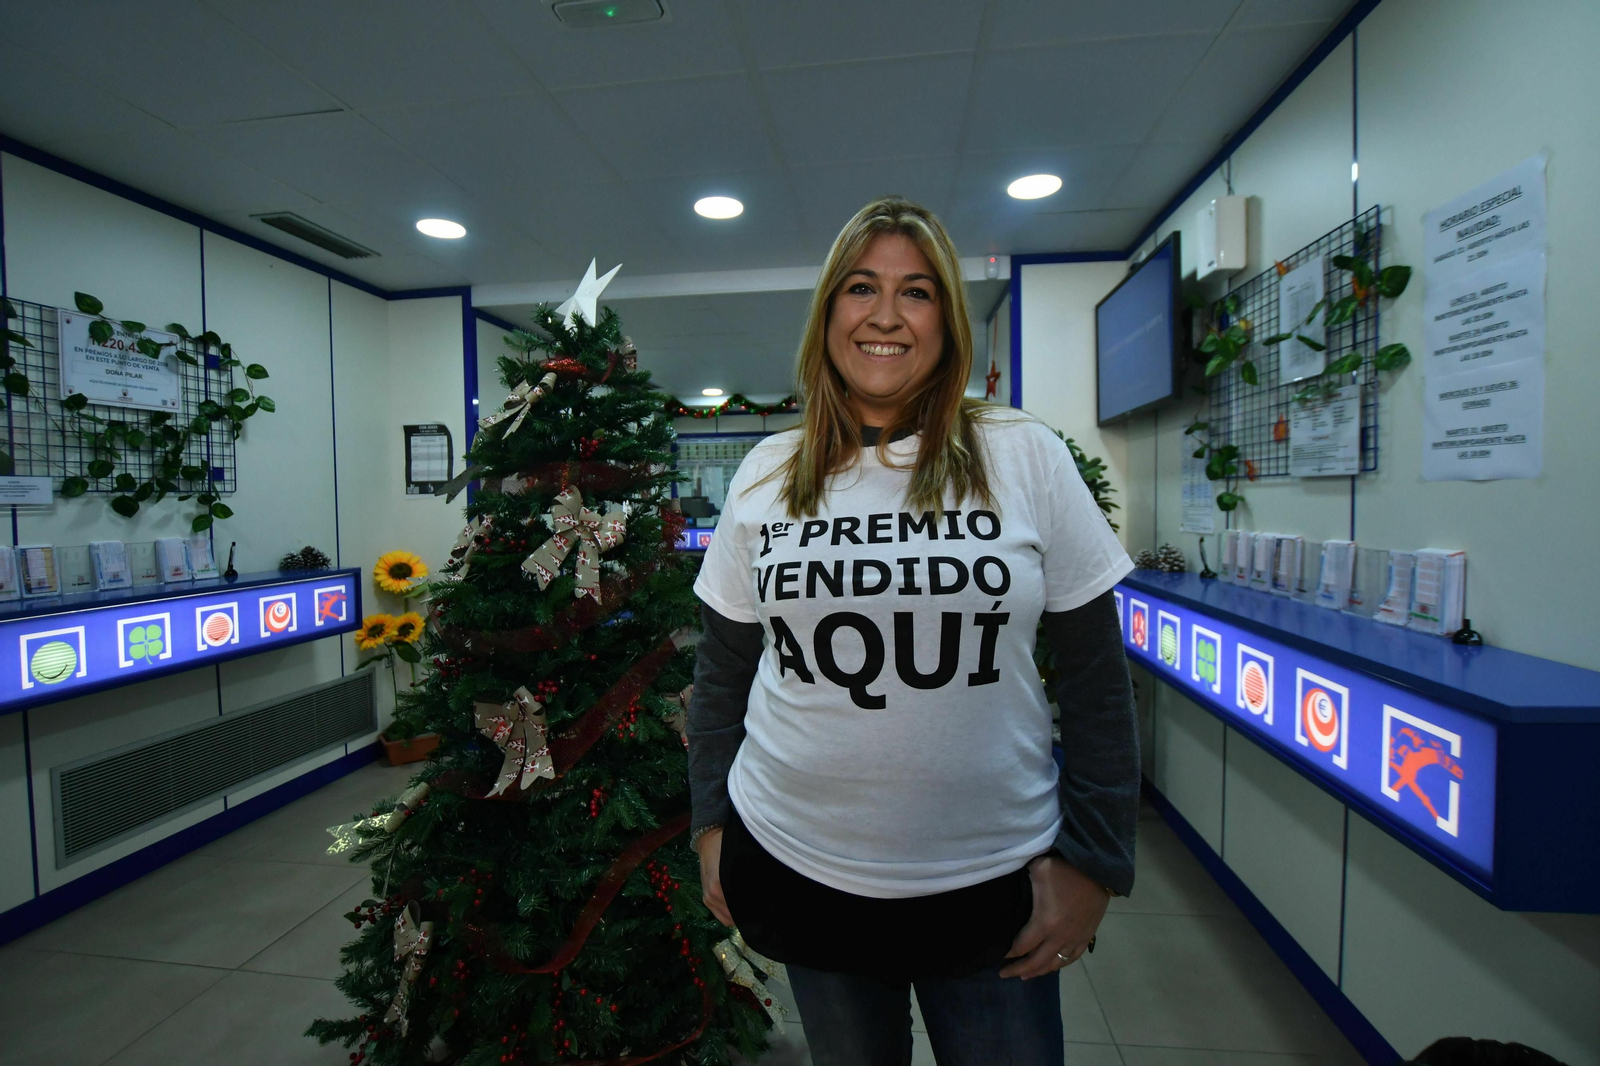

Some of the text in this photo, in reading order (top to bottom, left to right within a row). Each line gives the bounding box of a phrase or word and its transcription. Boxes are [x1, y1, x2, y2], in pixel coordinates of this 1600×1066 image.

[1481, 185, 1523, 212] ESPECIAL
[1494, 225, 1516, 240] HASTA
[1517, 219, 1531, 232] LAS
[85, 347, 113, 358] PREMIOS
[128, 356, 148, 364] LARGO
[96, 356, 111, 364] ESTE
[111, 359, 132, 367] PUNTO
[142, 363, 160, 372] VENTA
[105, 367, 143, 379] DOÑA PILAR
[799, 509, 1002, 547] PREMIO
[757, 555, 1011, 603] VENDIDO
[769, 601, 1010, 710] AQUÍ
